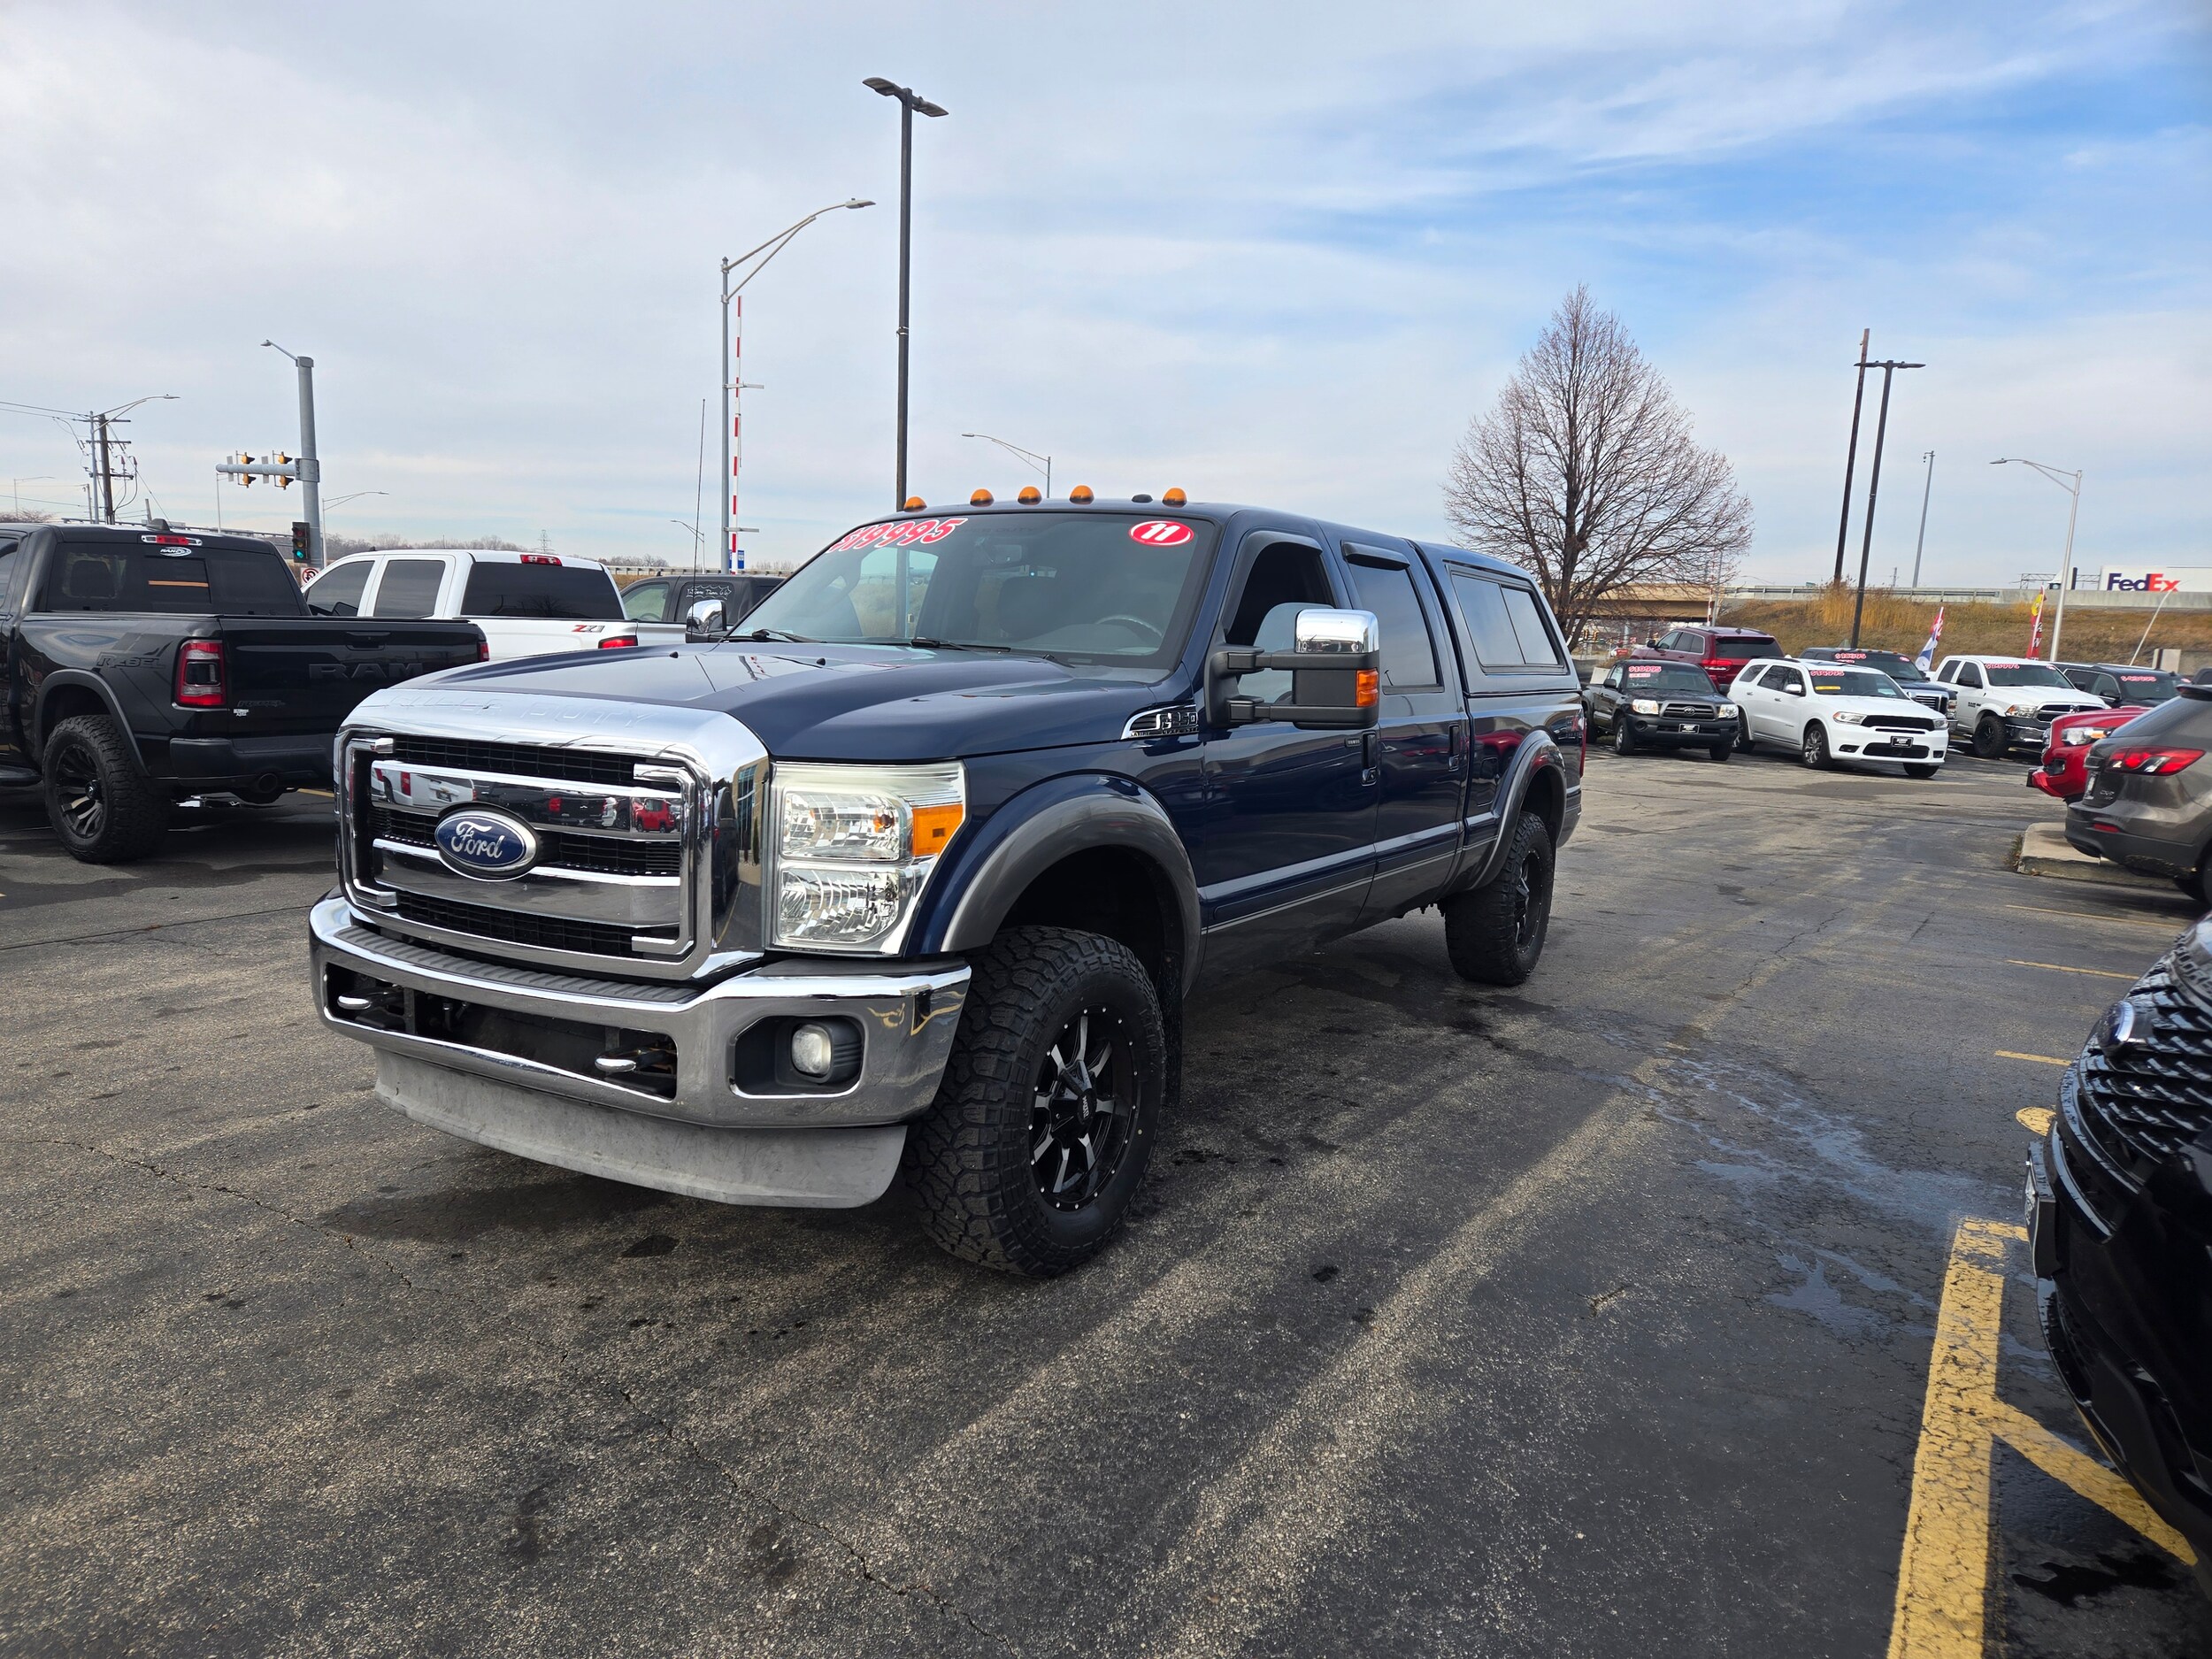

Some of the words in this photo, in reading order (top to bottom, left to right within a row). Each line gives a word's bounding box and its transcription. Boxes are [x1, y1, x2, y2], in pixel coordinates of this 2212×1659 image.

[1141, 523, 1181, 541] 11
[2107, 572, 2181, 592] FedEx
[309, 664, 423, 680] RAM
[450, 820, 505, 858] Ford
